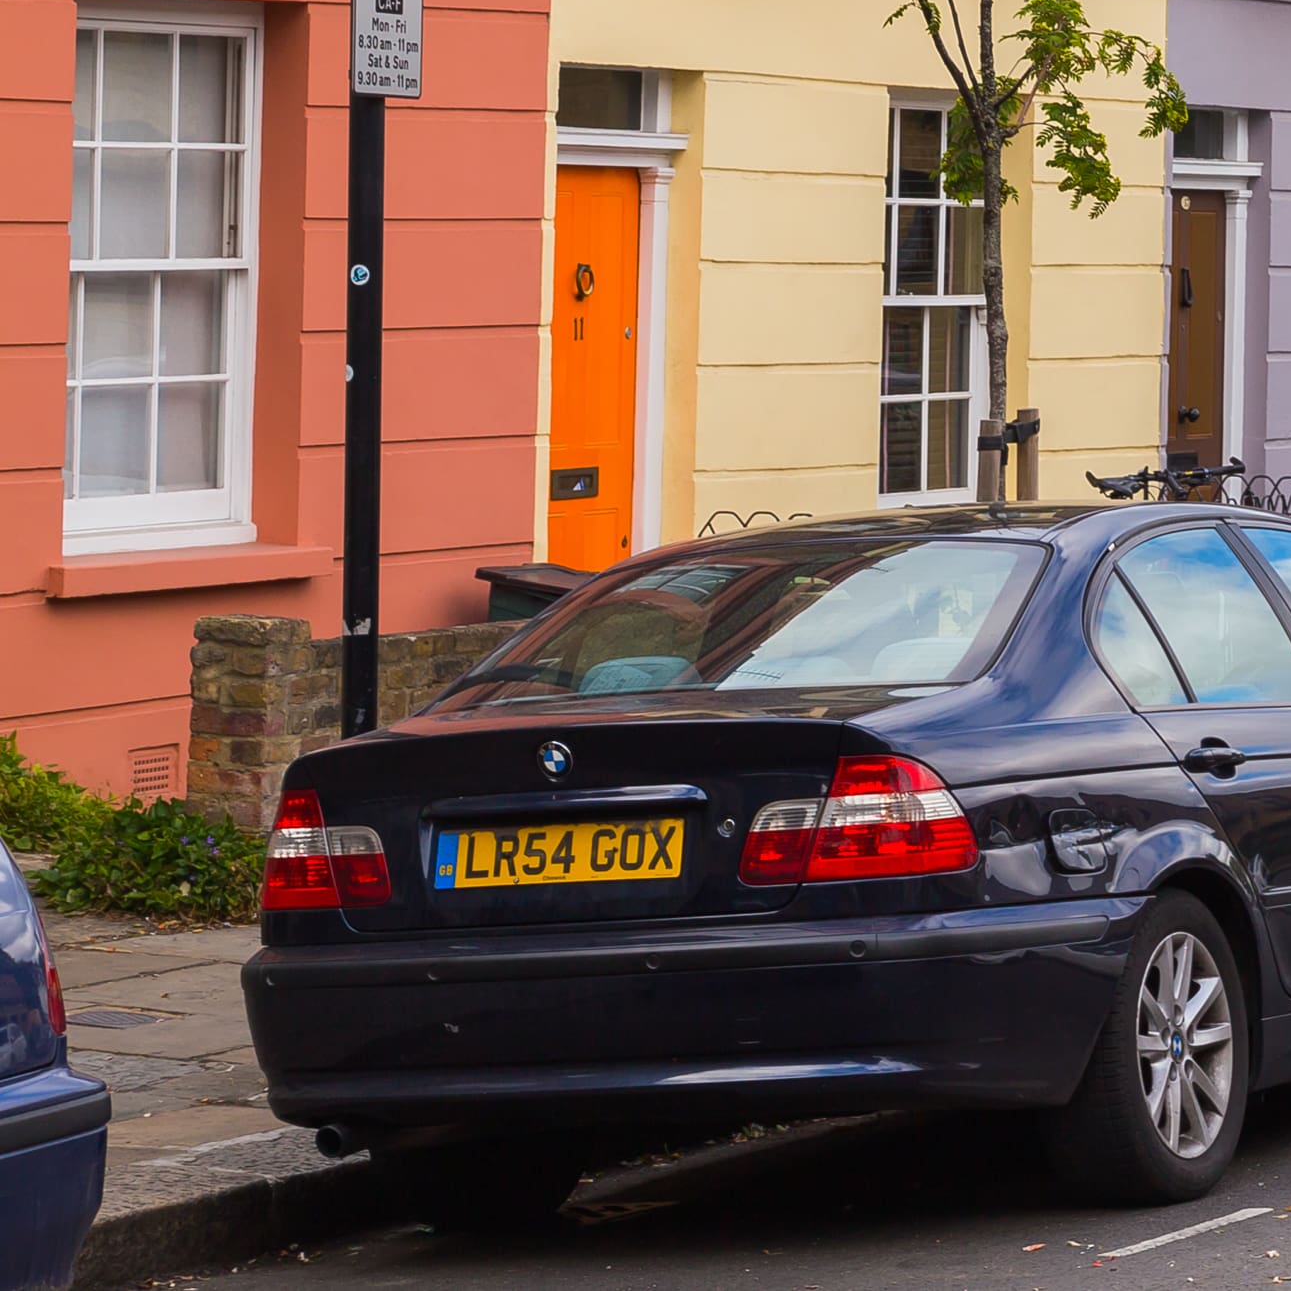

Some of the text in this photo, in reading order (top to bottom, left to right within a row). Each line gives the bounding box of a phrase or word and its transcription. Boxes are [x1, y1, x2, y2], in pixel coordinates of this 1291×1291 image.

[372, 17, 389, 32] Mon
[395, 19, 407, 34] Fri
[358, 34, 378, 49] 8.30
[380, 39, 392, 51] am
[398, 38, 405, 51] 11
[406, 42, 419, 54] pm
[368, 53, 409, 70] Sat & Sun
[357, 71, 378, 86] 9.30
[379, 76, 391, 87] am
[397, 74, 404, 88] 11
[405, 77, 418, 90] pm
[574, 316, 584, 341] 11
[465, 826, 676, 879] LR54 GOX
[439, 864, 453, 876] GB
